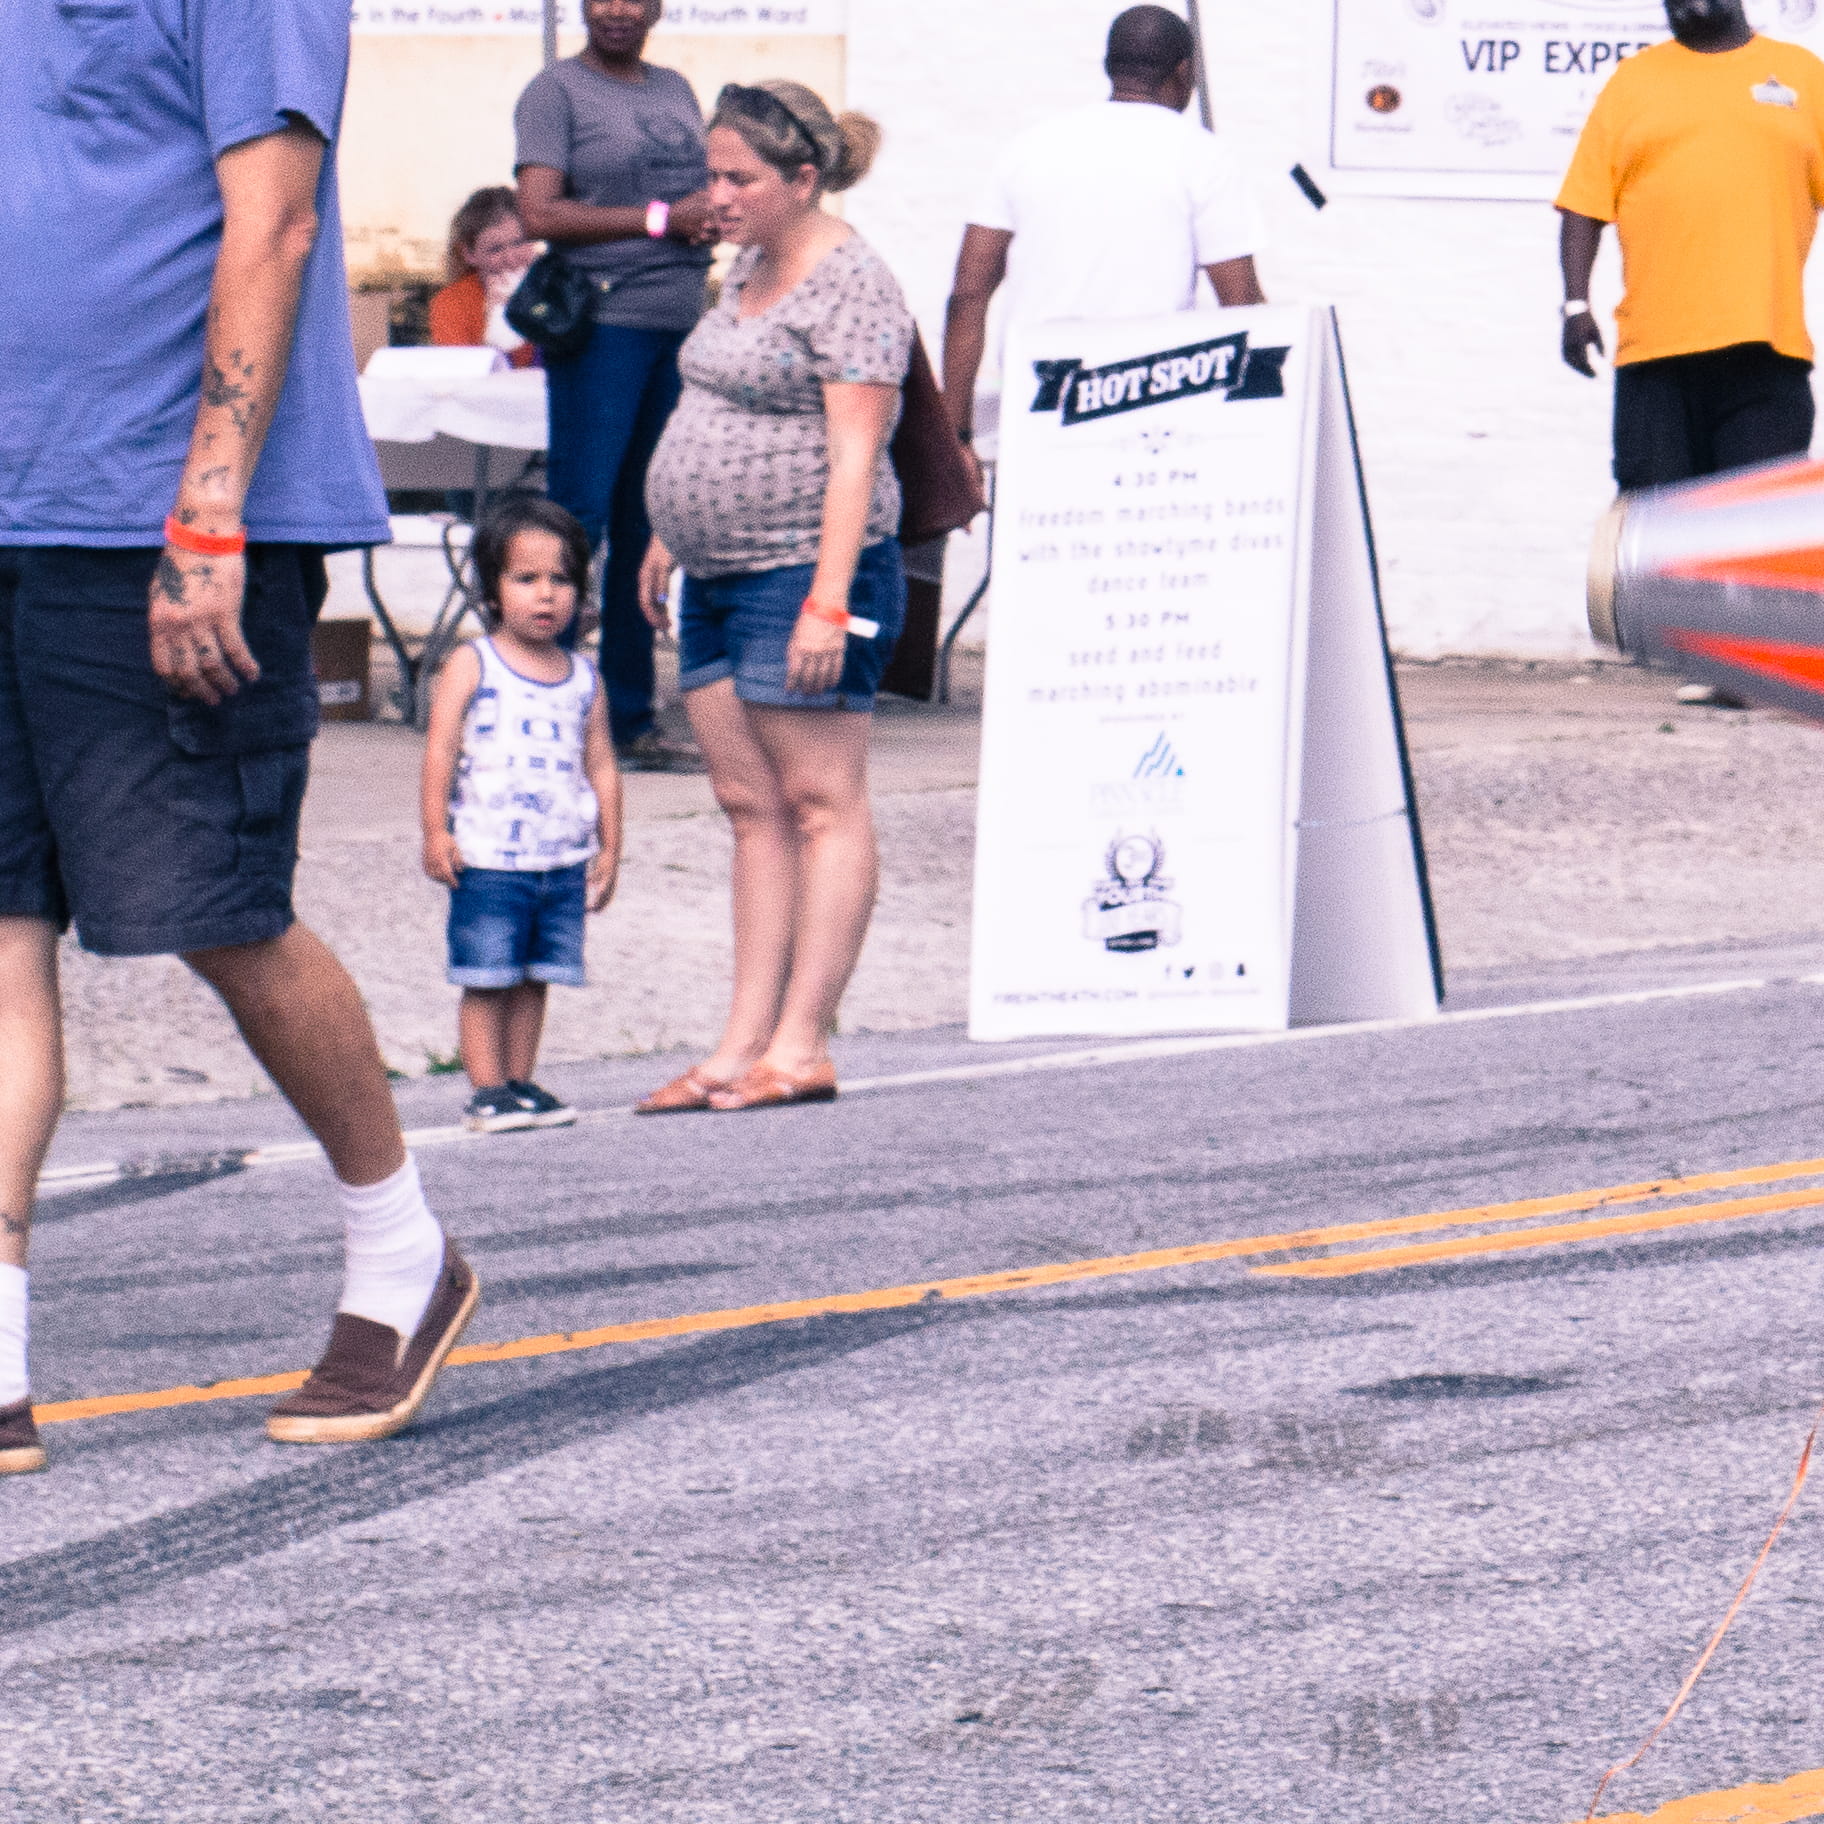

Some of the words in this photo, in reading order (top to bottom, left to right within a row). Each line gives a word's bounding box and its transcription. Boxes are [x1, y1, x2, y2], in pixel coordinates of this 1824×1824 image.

[391, 7, 419, 23] the
[427, 7, 484, 24] Fourth
[689, 7, 749, 24] Fourth
[757, 7, 807, 24] Ward
[1460, 40, 1520, 73] VIP
[1077, 367, 1147, 412] HOT
[1150, 345, 1235, 395] SPOT
[1168, 468, 1198, 484] PM
[1117, 503, 1214, 526] marching
[1225, 497, 1285, 518] bands
[1018, 542, 1060, 563] with
[1070, 539, 1103, 560] the
[1087, 572, 1148, 594] dance
[1159, 571, 1209, 590] team
[1160, 609, 1190, 626] PM
[1068, 646, 1119, 667] seed
[1129, 643, 1165, 664] and
[1028, 682, 1126, 704] marching
